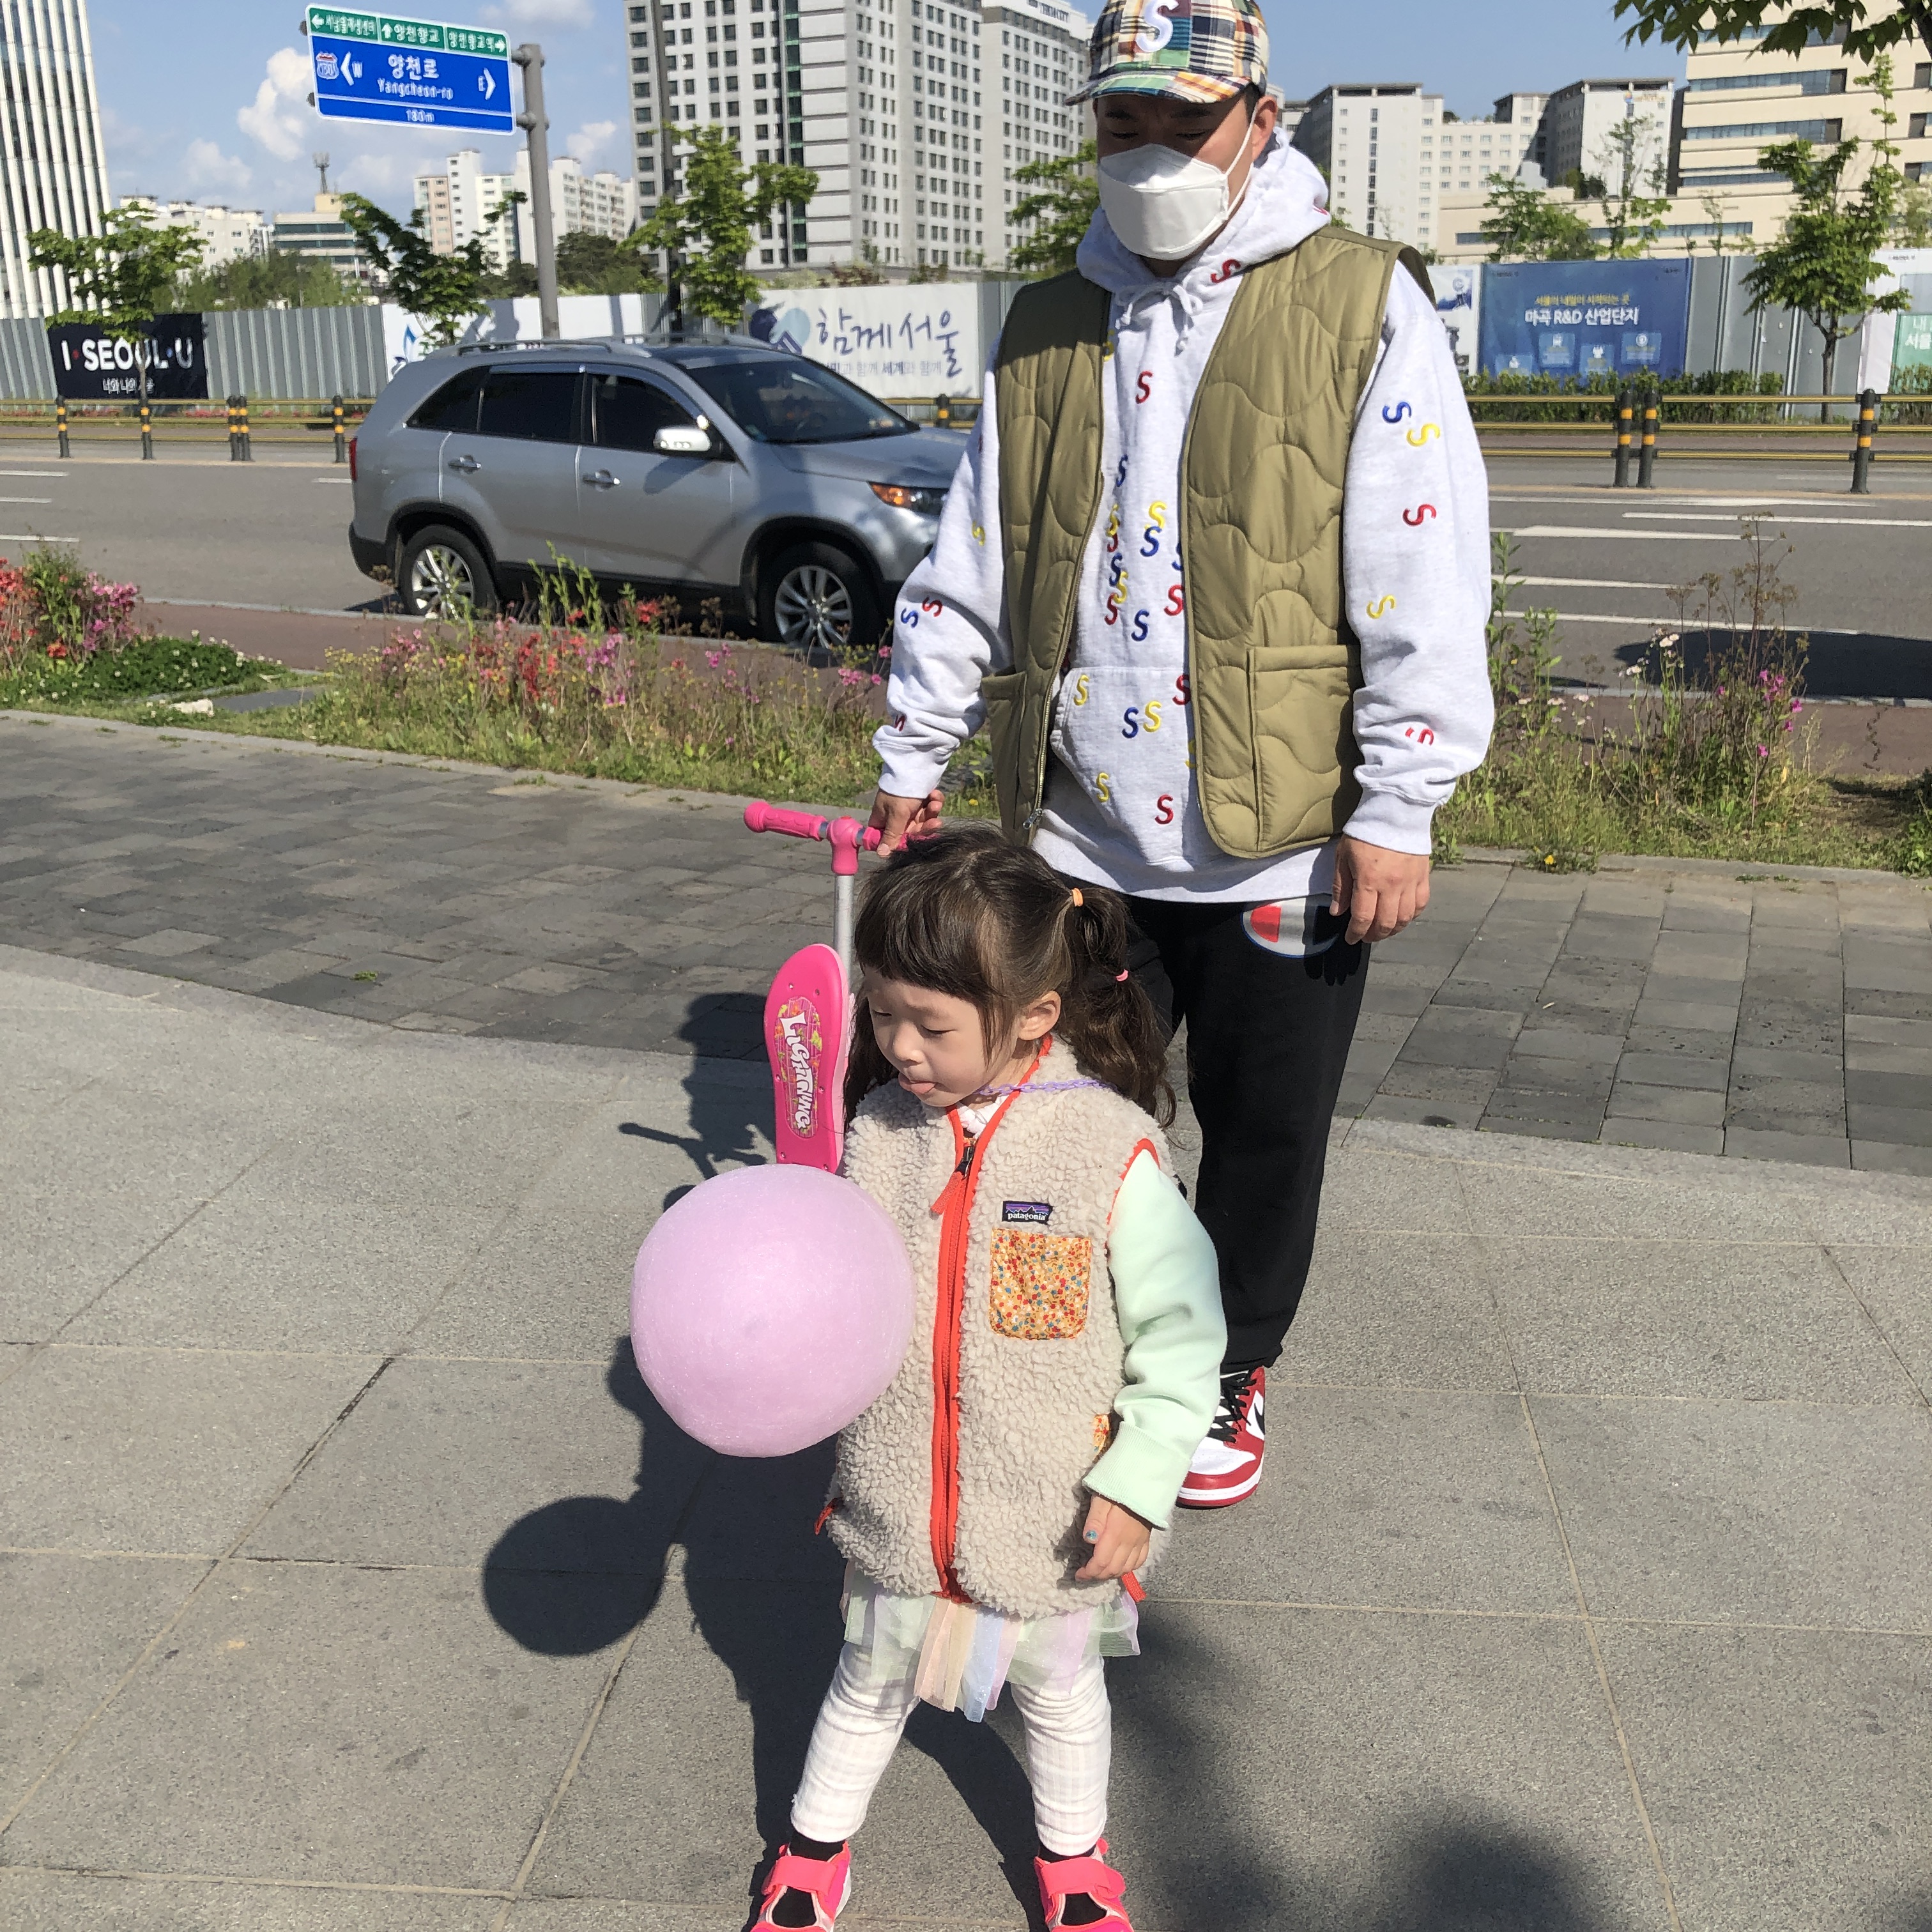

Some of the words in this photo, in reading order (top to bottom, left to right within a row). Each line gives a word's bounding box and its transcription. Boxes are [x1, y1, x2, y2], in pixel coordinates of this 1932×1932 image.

[394, 24, 440, 44] 양천향교
[448, 31, 495, 52] 양천향교역
[1135, 0, 1179, 52] S
[388, 54, 439, 80] 양천로
[377, 77, 454, 100] Yangcheon-ro
[406, 109, 434, 122] 180m
[1210, 259, 1241, 284] S
[1525, 308, 1551, 326] 마곡
[1554, 309, 1583, 325] R&D
[1584, 306, 1639, 325] 산업단지
[816, 307, 892, 356] 함께
[899, 309, 962, 378] 서울
[1135, 371, 1153, 404] S
[1382, 401, 1411, 424] S
[1406, 423, 1440, 447] S
[1116, 454, 1128, 487] S
[1144, 500, 1167, 533] S
[1403, 503, 1436, 526] S
[1140, 526, 1162, 557] S
[1109, 553, 1123, 586] S
[1113, 571, 1128, 604] S
[1163, 584, 1184, 617] S
[901, 608, 919, 629] S
[922, 597, 943, 617] S
[1104, 592, 1118, 625] S
[1366, 594, 1395, 619] S
[1131, 609, 1149, 642] S
[1073, 675, 1089, 706] S
[1172, 674, 1190, 705] S
[1122, 707, 1138, 739] S
[1143, 701, 1161, 733] S
[1096, 772, 1109, 802] S
[1154, 793, 1174, 825] S
[1008, 1213, 1046, 1221] patagonia
